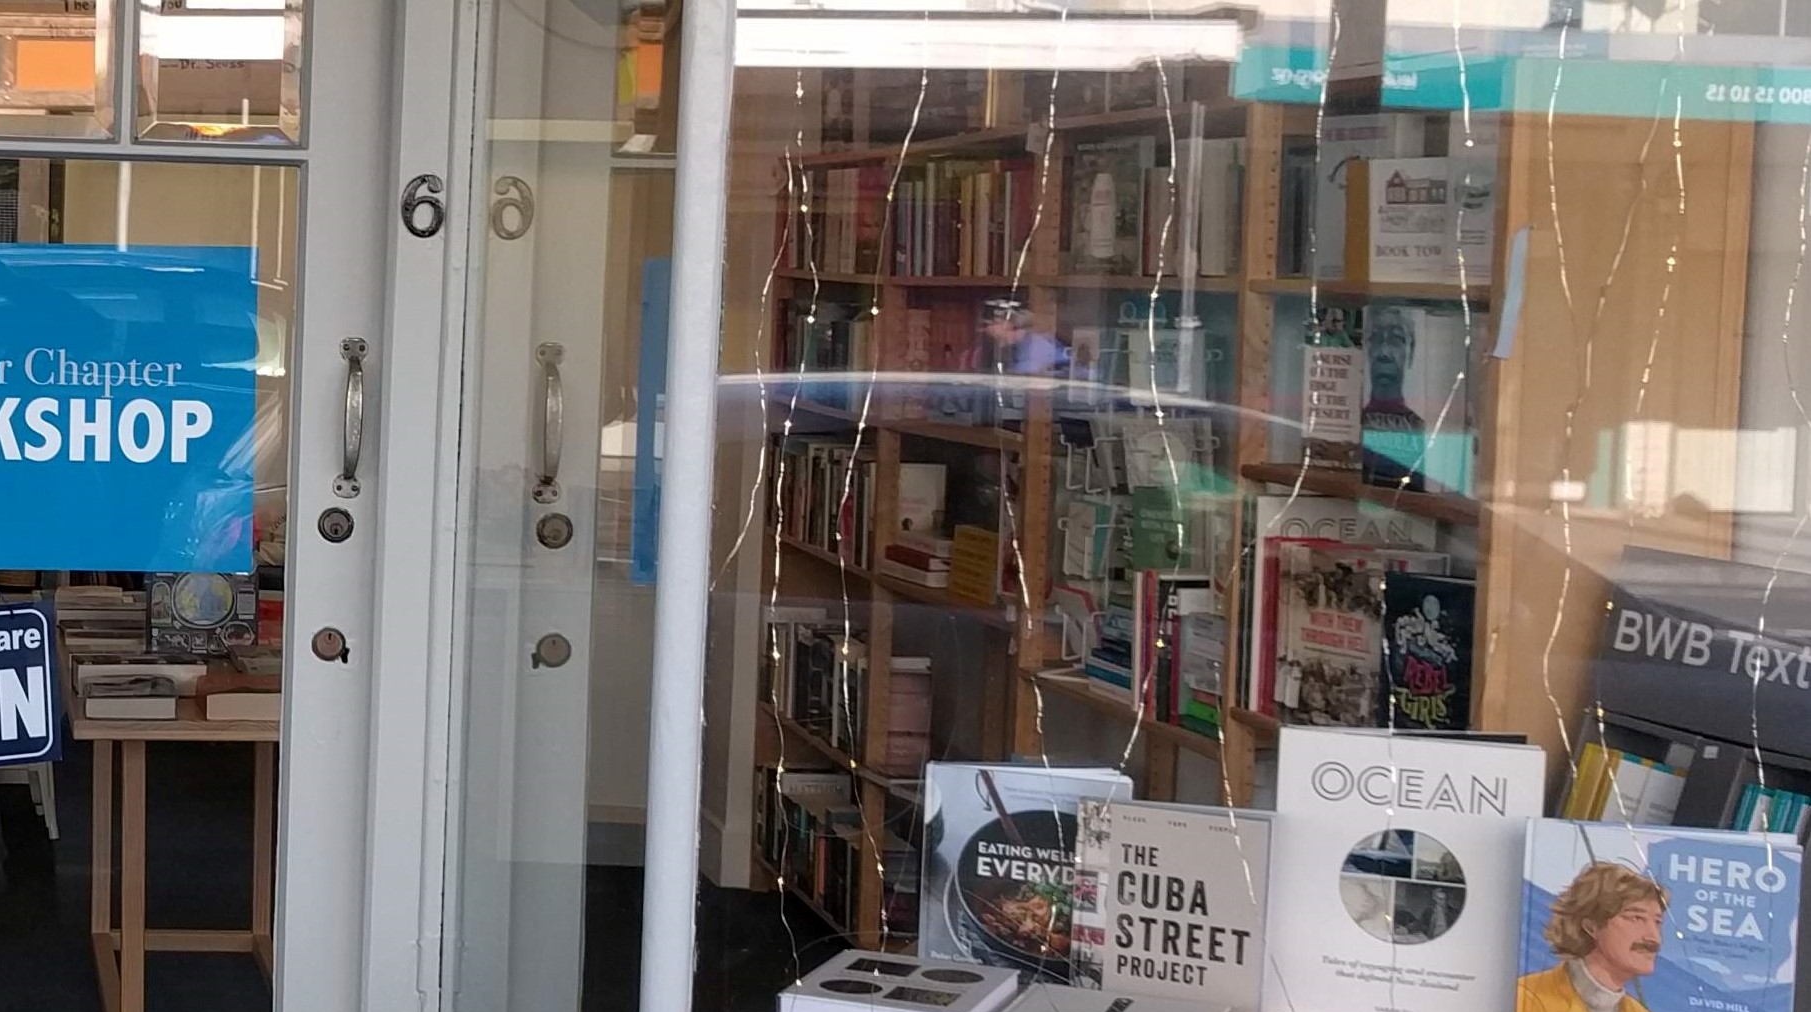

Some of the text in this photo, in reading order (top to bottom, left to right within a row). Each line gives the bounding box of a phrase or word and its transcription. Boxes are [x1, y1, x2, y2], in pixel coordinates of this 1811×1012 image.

[400, 173, 445, 239] 6
[23, 347, 183, 399] Chapter
[1280, 517, 1414, 546] OCEAN
[1612, 608, 1715, 667] BWB
[1311, 760, 1509, 818] OCEAN
[977, 840, 1032, 860] EATING
[1121, 842, 1161, 868] THE
[976, 856, 1076, 887] EVERYD
[1668, 853, 1788, 895] HERO
[1116, 869, 1210, 918] CUBA
[1694, 888, 1757, 909] OF THE
[1114, 913, 1253, 967] STREET
[1686, 904, 1765, 942] SEA
[1116, 954, 1209, 988] PROJECT
[1688, 995, 1725, 1010] DAVID
